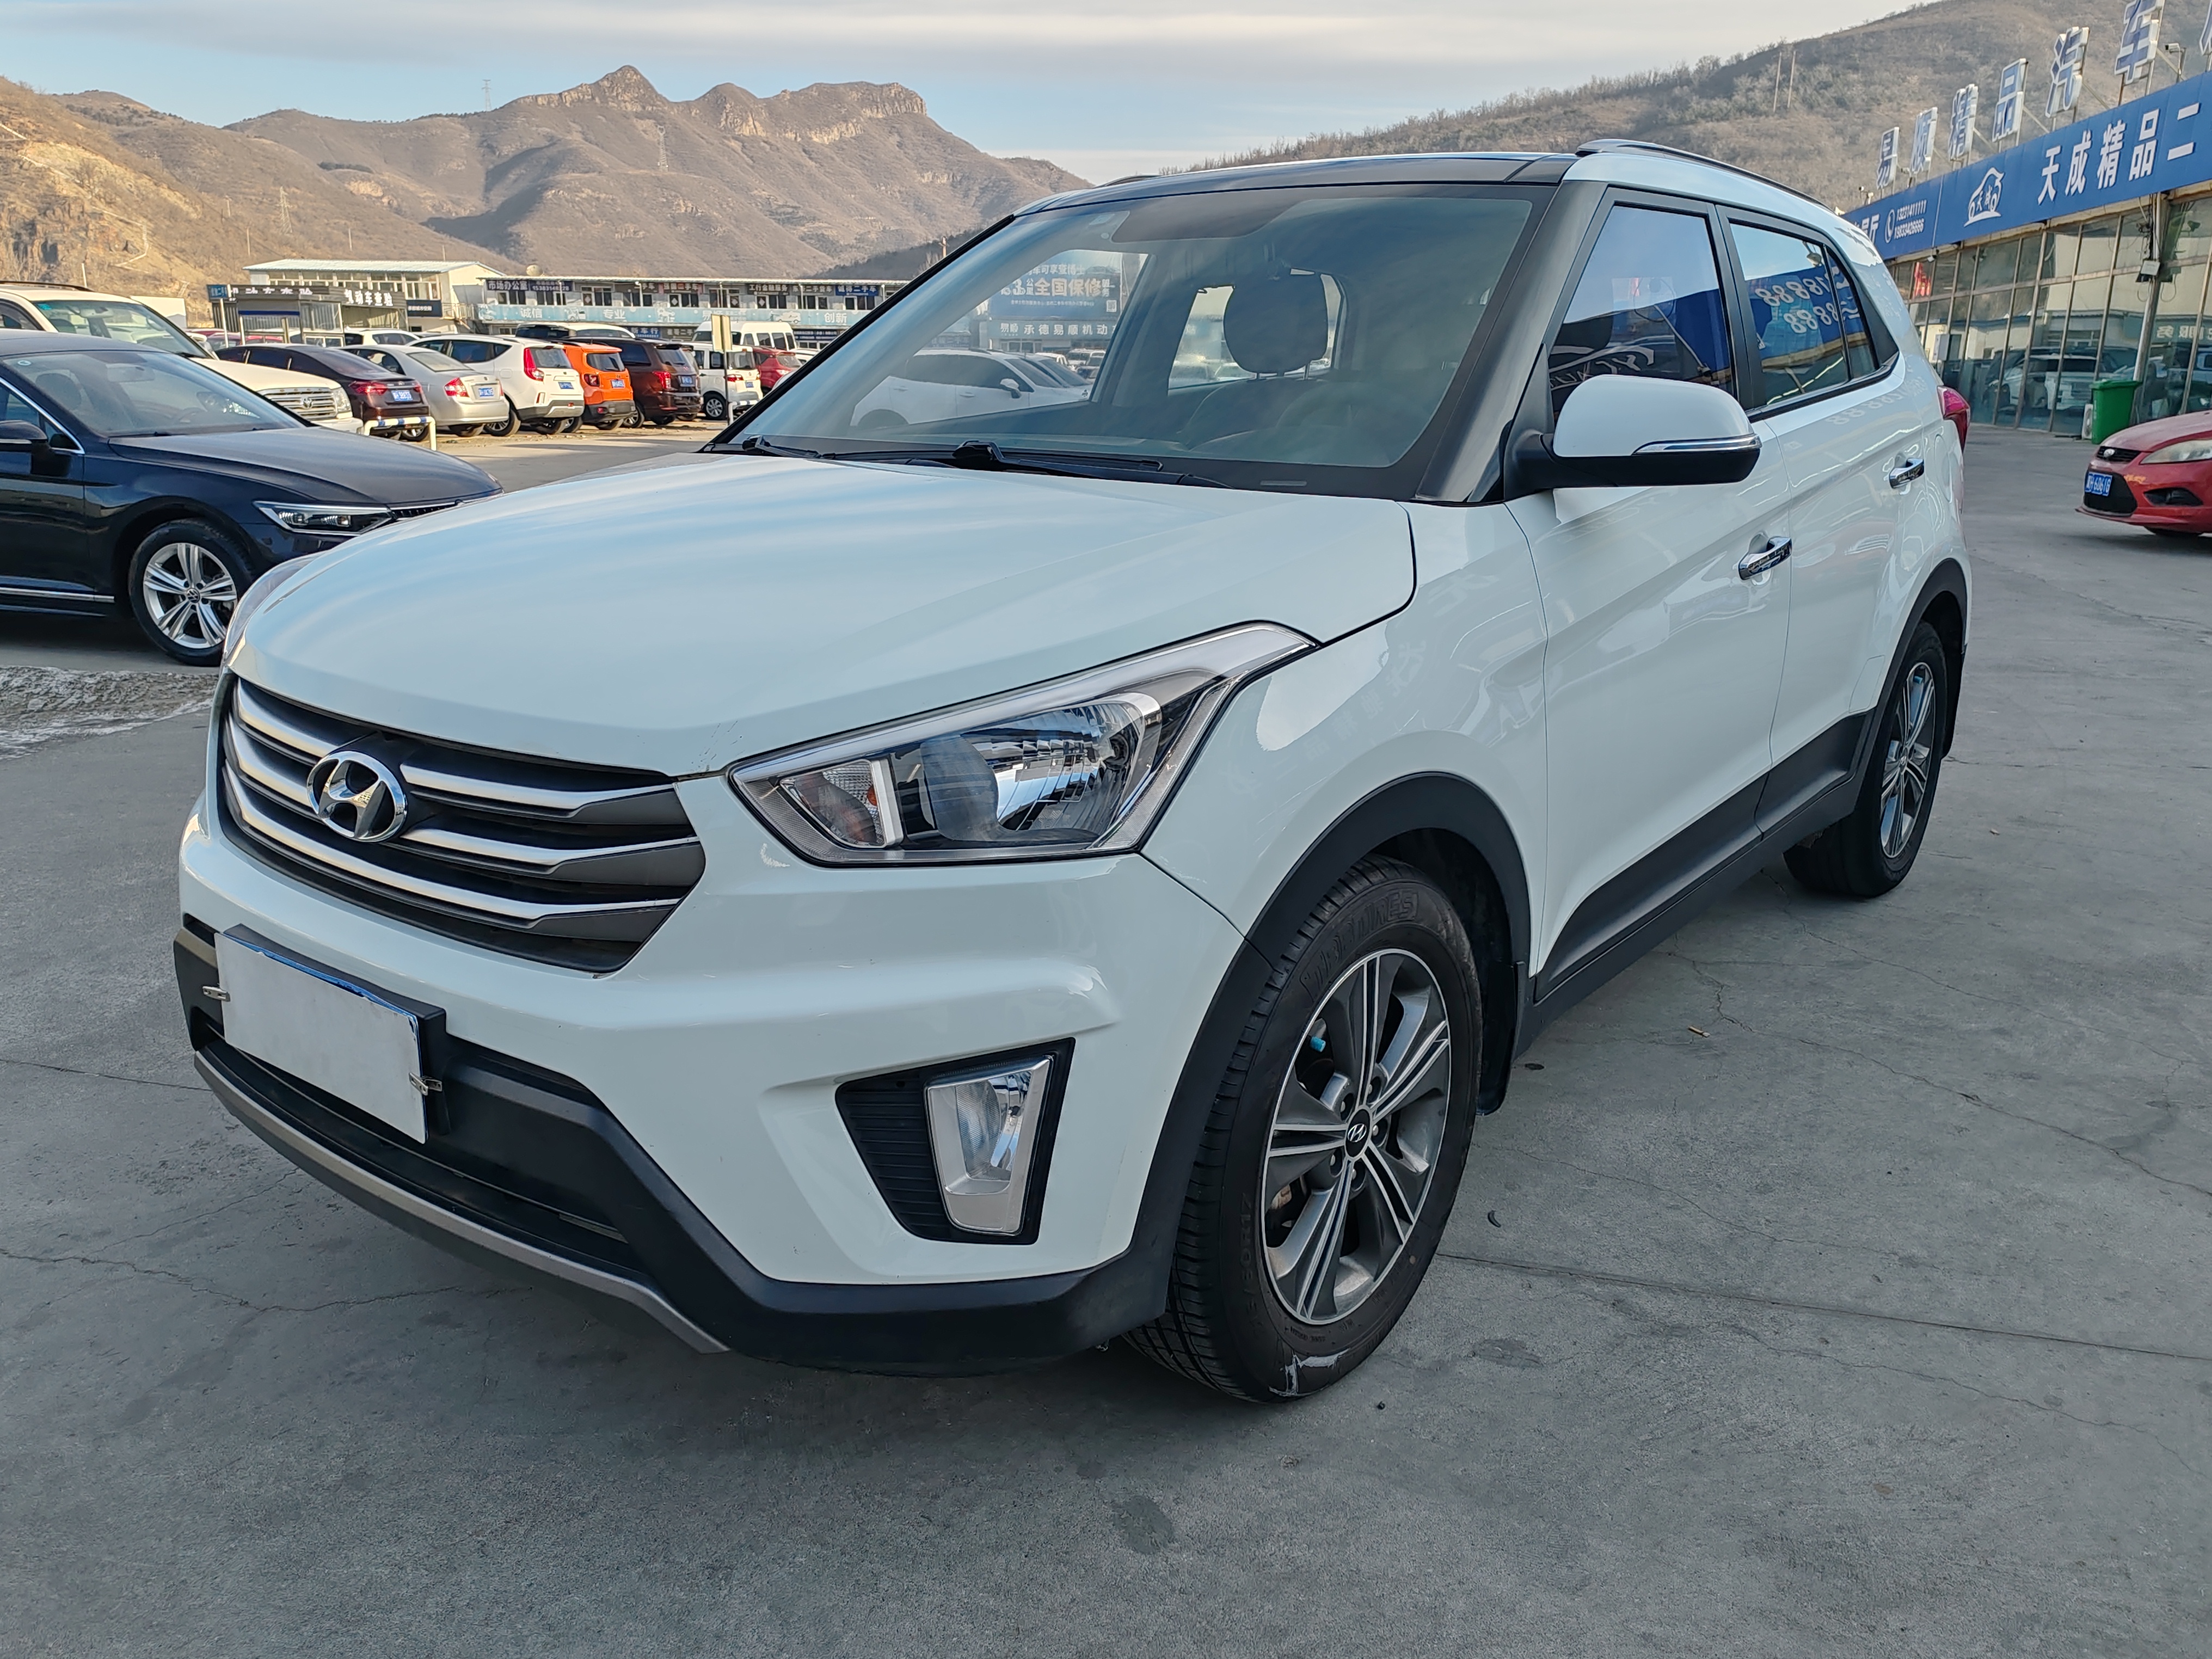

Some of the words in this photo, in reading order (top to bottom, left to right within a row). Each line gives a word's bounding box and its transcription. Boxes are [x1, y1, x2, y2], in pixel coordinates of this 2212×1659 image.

[489, 280, 528, 291] 市场办公室
[603, 309, 626, 319] 专业
[824, 312, 847, 323] 创新
[1024, 324, 1117, 335] 承德易顺机动
